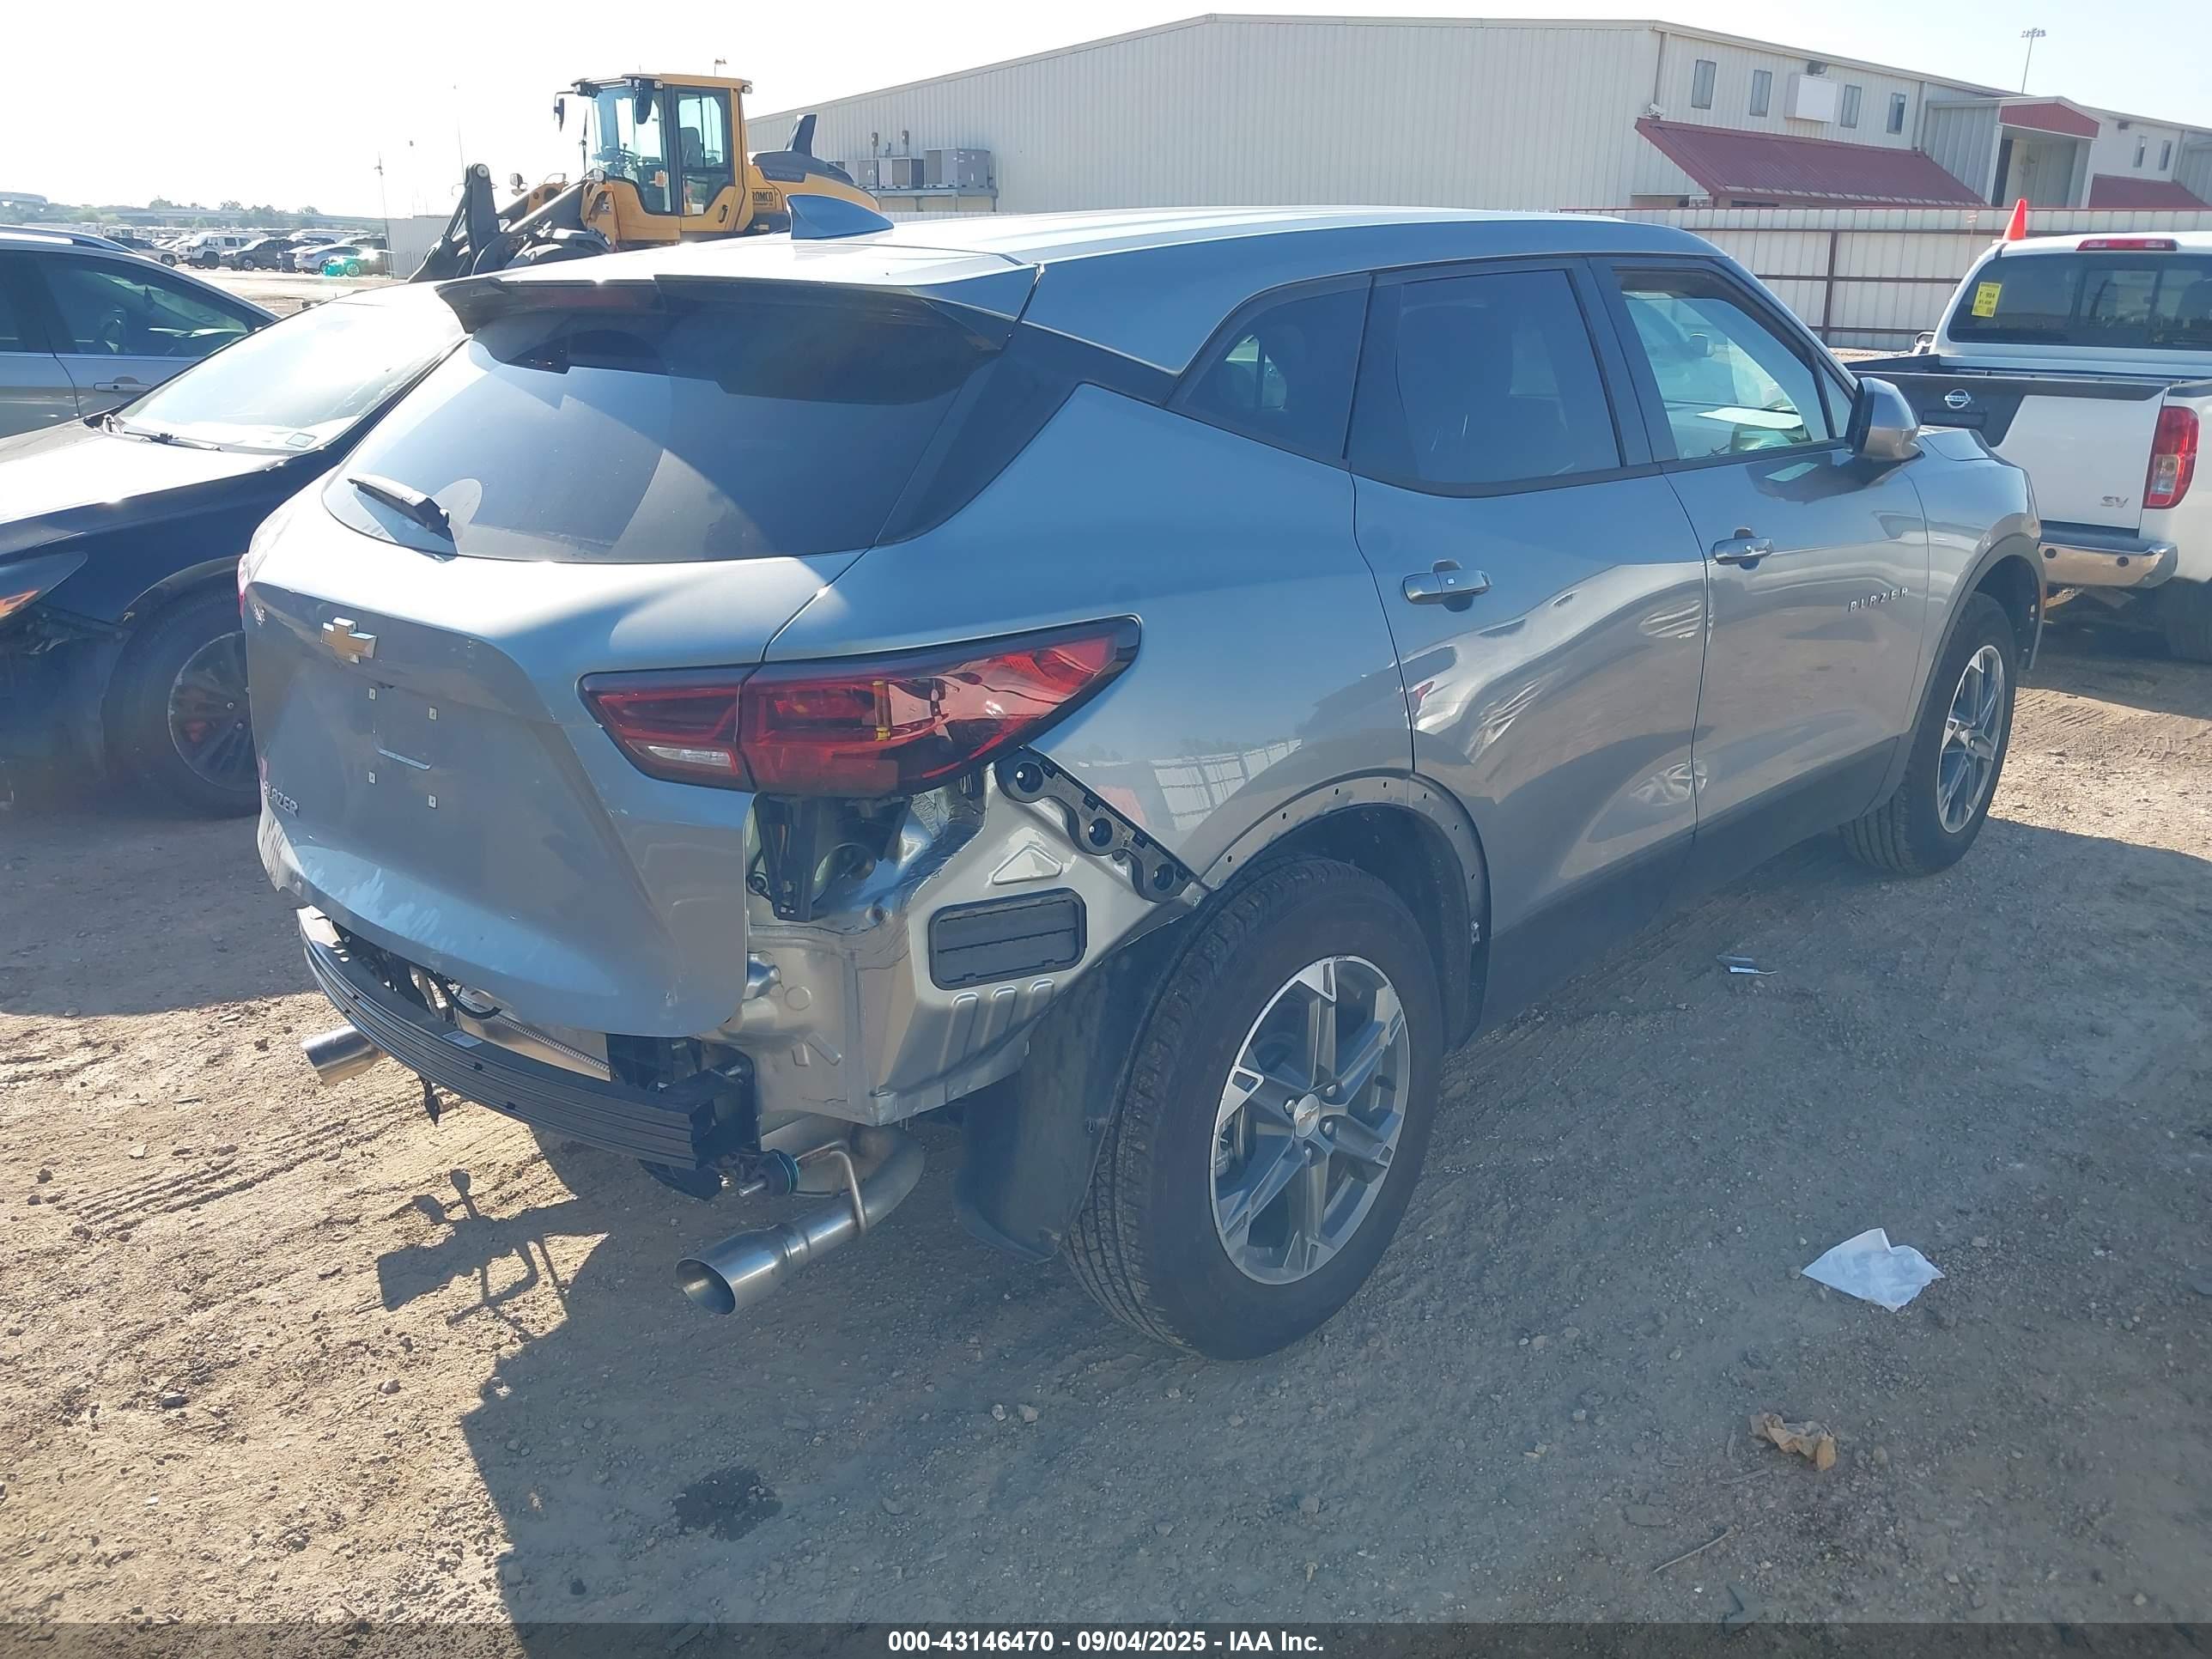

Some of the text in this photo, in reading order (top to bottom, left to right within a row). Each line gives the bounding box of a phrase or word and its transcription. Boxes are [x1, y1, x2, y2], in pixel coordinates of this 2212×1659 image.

[2100, 495, 2129, 507] SV
[1848, 586, 1908, 612] BLAZER
[264, 781, 300, 818] BLAZER
